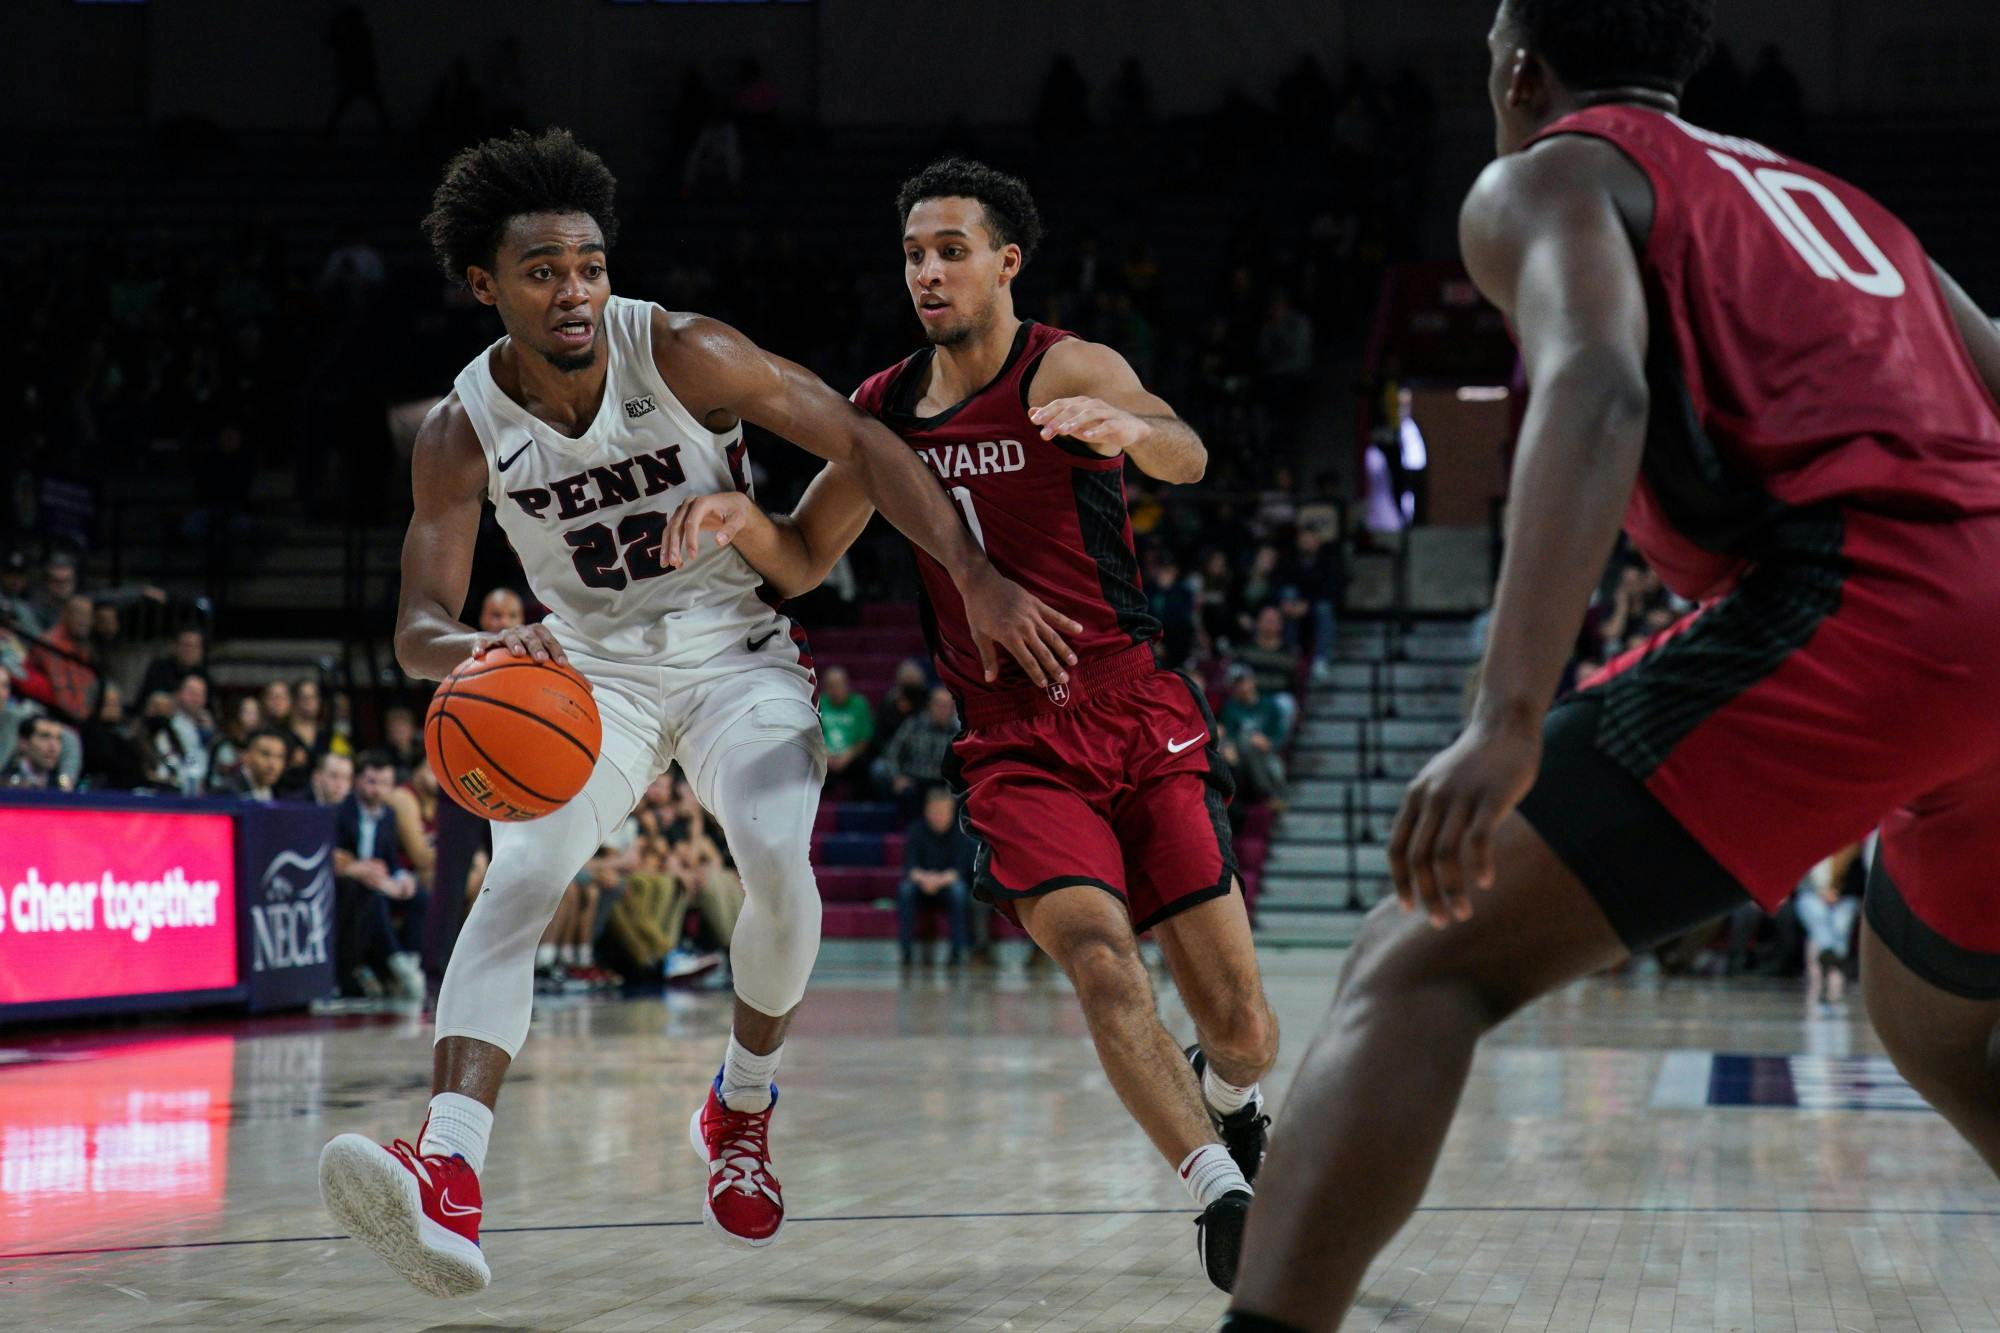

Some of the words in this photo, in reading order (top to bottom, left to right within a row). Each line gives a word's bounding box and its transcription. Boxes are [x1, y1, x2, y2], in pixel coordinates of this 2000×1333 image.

[1705, 148, 1906, 298] 10
[507, 444, 686, 520] PENN
[917, 440, 1025, 478] VARD
[563, 510, 677, 591] 22
[947, 486, 986, 553] 1
[1051, 684, 1066, 700] H
[460, 770, 538, 819] ELITE
[10, 867, 98, 932] cheer
[101, 867, 220, 942] together
[251, 899, 327, 972] NECA
